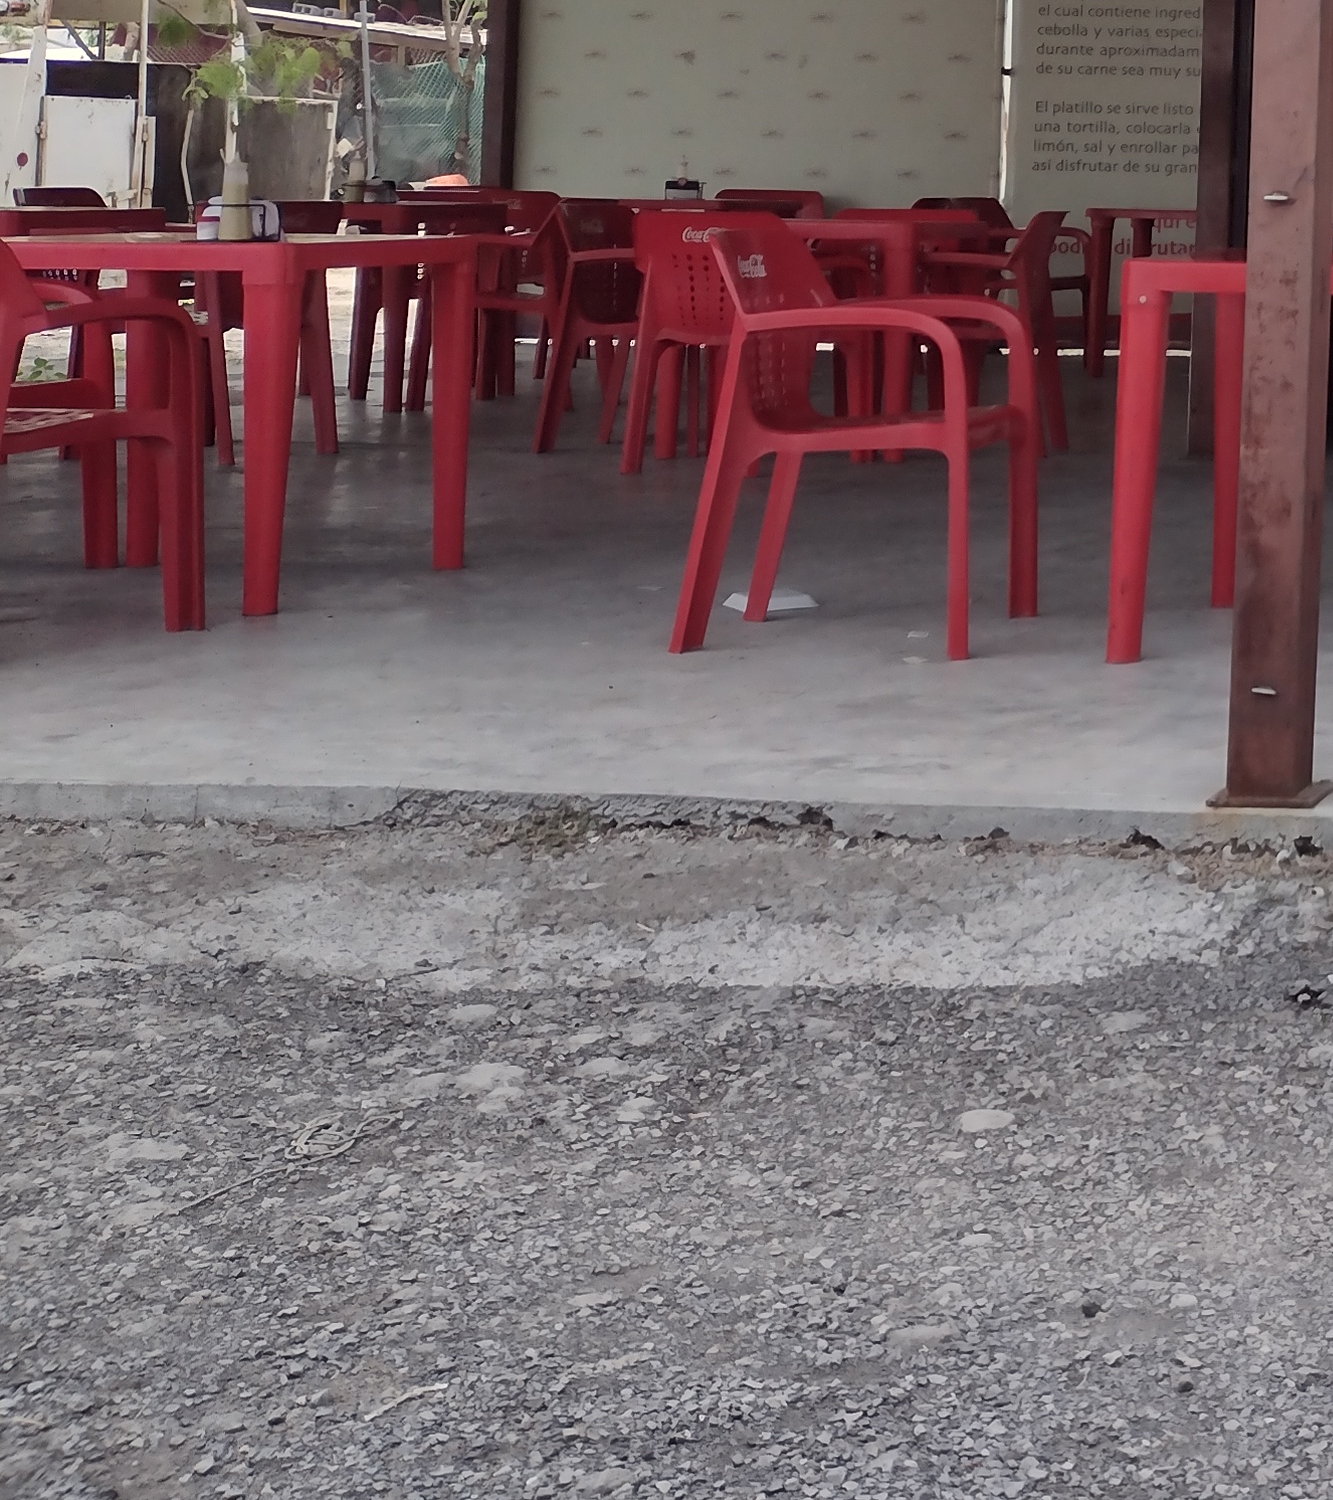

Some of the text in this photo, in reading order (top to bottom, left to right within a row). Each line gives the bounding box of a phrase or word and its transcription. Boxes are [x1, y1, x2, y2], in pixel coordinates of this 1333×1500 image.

[1038, 4, 1200, 22] el cual contiene ingred
[1037, 24, 1088, 37] cebolla
[1094, 28, 1102, 39] y
[1108, 25, 1149, 38] varias
[1036, 43, 1094, 56] durante
[1100, 45, 1200, 59] aproximadam
[1036, 62, 1053, 74] de
[1057, 64, 1073, 75] su
[1077, 65, 1117, 76] carne
[1122, 66, 1144, 77] sea
[1150, 66, 1181, 80] muy
[1036, 101, 1194, 117] El platillo se sirve listo
[1034, 120, 1191, 136] una tortilla, colocarla
[1033, 139, 1079, 155] limón,
[1084, 140, 1103, 153] sal
[1107, 143, 1116, 156] y
[1120, 141, 1177, 154] enrollar
[1055, 158, 1119, 173] disfrutar
[1123, 160, 1141, 173] de
[1145, 162, 1160, 173] su
